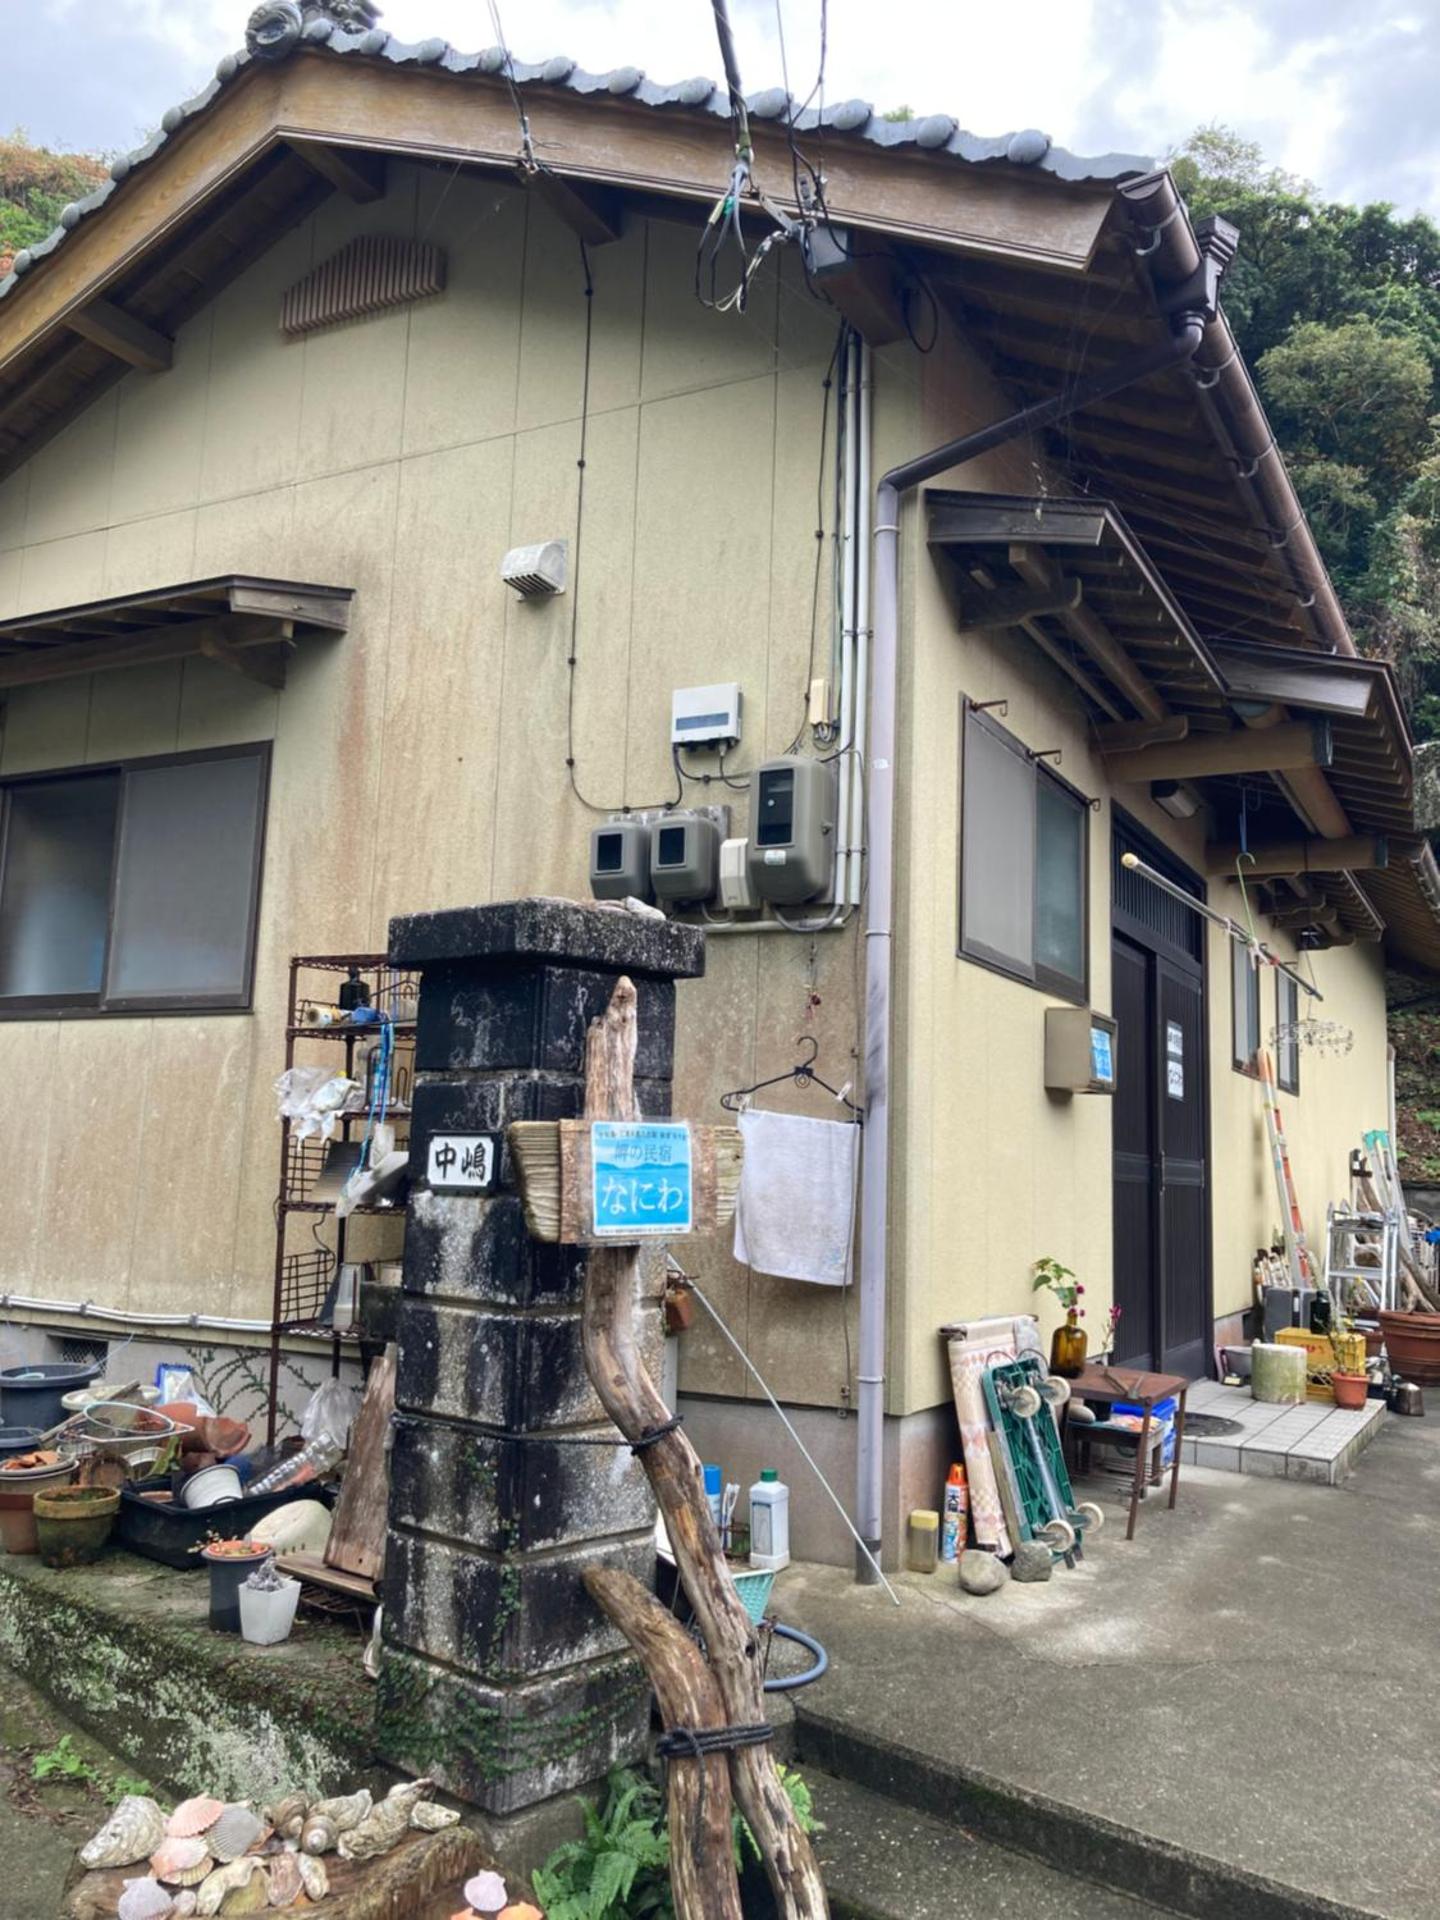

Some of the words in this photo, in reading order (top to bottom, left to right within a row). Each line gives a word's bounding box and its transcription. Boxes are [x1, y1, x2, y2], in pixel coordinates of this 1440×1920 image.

[435, 1141, 486, 1182] 中嶋
[602, 1174, 684, 1216] なにわ
